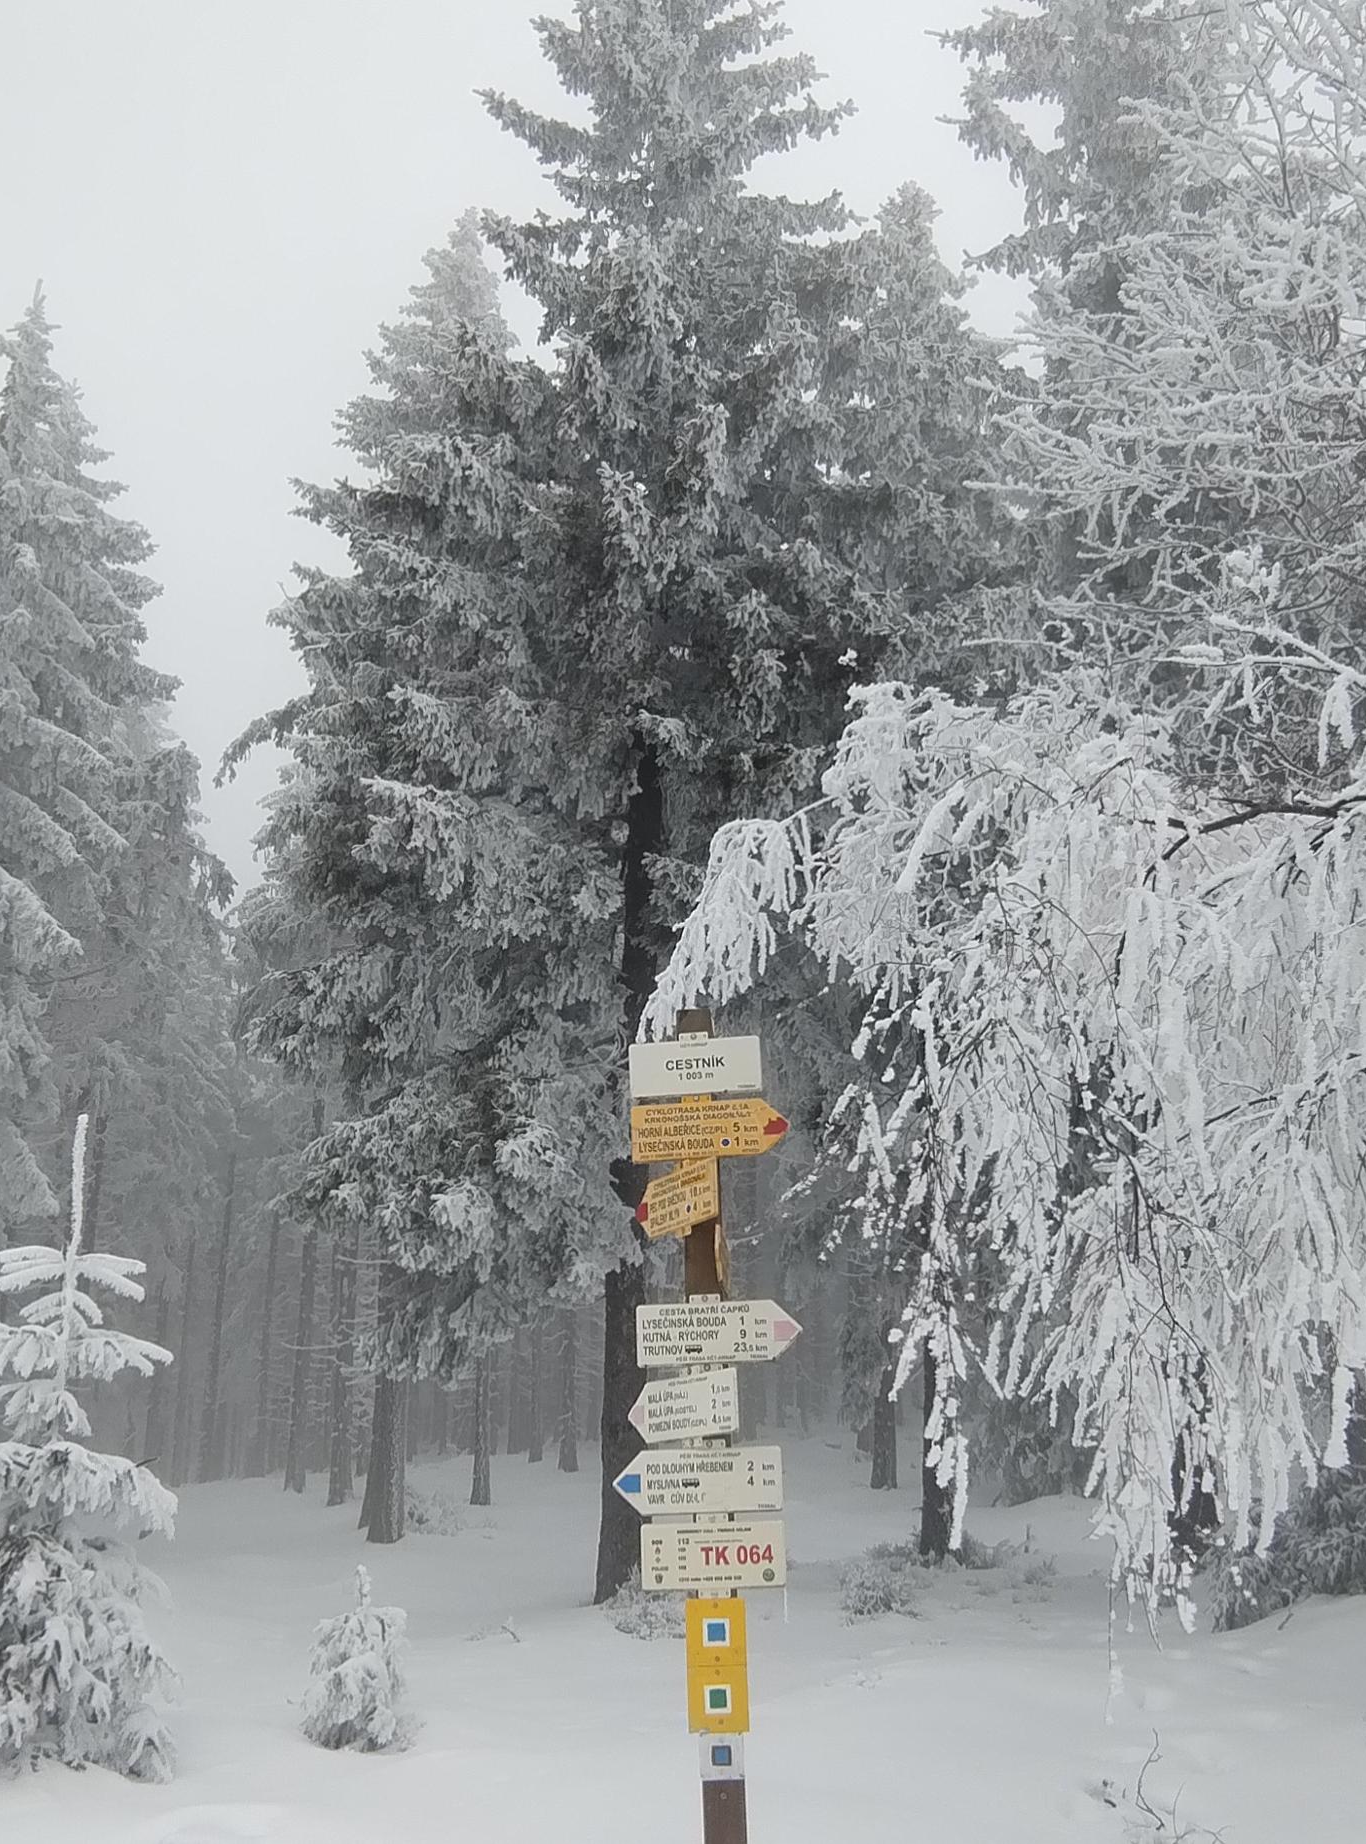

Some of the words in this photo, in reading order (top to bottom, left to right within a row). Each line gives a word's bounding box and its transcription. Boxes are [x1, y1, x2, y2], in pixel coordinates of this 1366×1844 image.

[665, 1055, 725, 1071] CESTNÍK
[678, 1073, 683, 1081] 1
[686, 1071, 702, 1080] 003
[705, 1071, 714, 1079] m
[646, 1106, 700, 1117] CYKLOTRASA
[702, 1103, 730, 1113] KRNAP
[644, 1112, 701, 1124] KRKONOŠSKÁ
[638, 1126, 663, 1138] HORNÍ
[664, 1122, 701, 1137] ALBEŘICE
[733, 1122, 741, 1133] 5
[743, 1125, 758, 1133] km
[687, 1138, 715, 1150] BOUDA
[734, 1137, 740, 1147] 1
[744, 1137, 759, 1146] km
[659, 1306, 686, 1316] CESTA
[688, 1304, 719, 1315] BRATŘÍ
[720, 1303, 750, 1314] ČAPKŮ
[642, 1316, 694, 1330] LYSEČINSKÁ
[696, 1315, 727, 1327] BOUDA
[739, 1316, 745, 1326] 1
[754, 1317, 767, 1325] km
[642, 1330, 672, 1343] KUTNÁ
[678, 1328, 720, 1341] RÝCHORY
[739, 1329, 747, 1339] 9
[754, 1330, 768, 1339] km
[643, 1344, 683, 1356] TRUTNOV
[733, 1341, 753, 1353] 23,5
[755, 1344, 768, 1352] km
[721, 1384, 730, 1393] km
[648, 1406, 663, 1419] MALÁ
[711, 1398, 717, 1409] 2
[721, 1400, 731, 1408] km
[672, 1418, 691, 1431] BOUDY
[722, 1414, 732, 1422] km
[646, 1463, 661, 1475] POD
[662, 1461, 695, 1474] DLOUHÝM
[695, 1460, 734, 1473] HŘEBENEM
[747, 1460, 754, 1471] 2
[762, 1463, 775, 1471] km
[646, 1478, 681, 1490] MYSLIVNA
[747, 1475, 755, 1486] 4
[762, 1478, 776, 1486] km
[677, 1537, 690, 1545] 112
[700, 1545, 731, 1566] TK
[736, 1543, 775, 1565] 064
